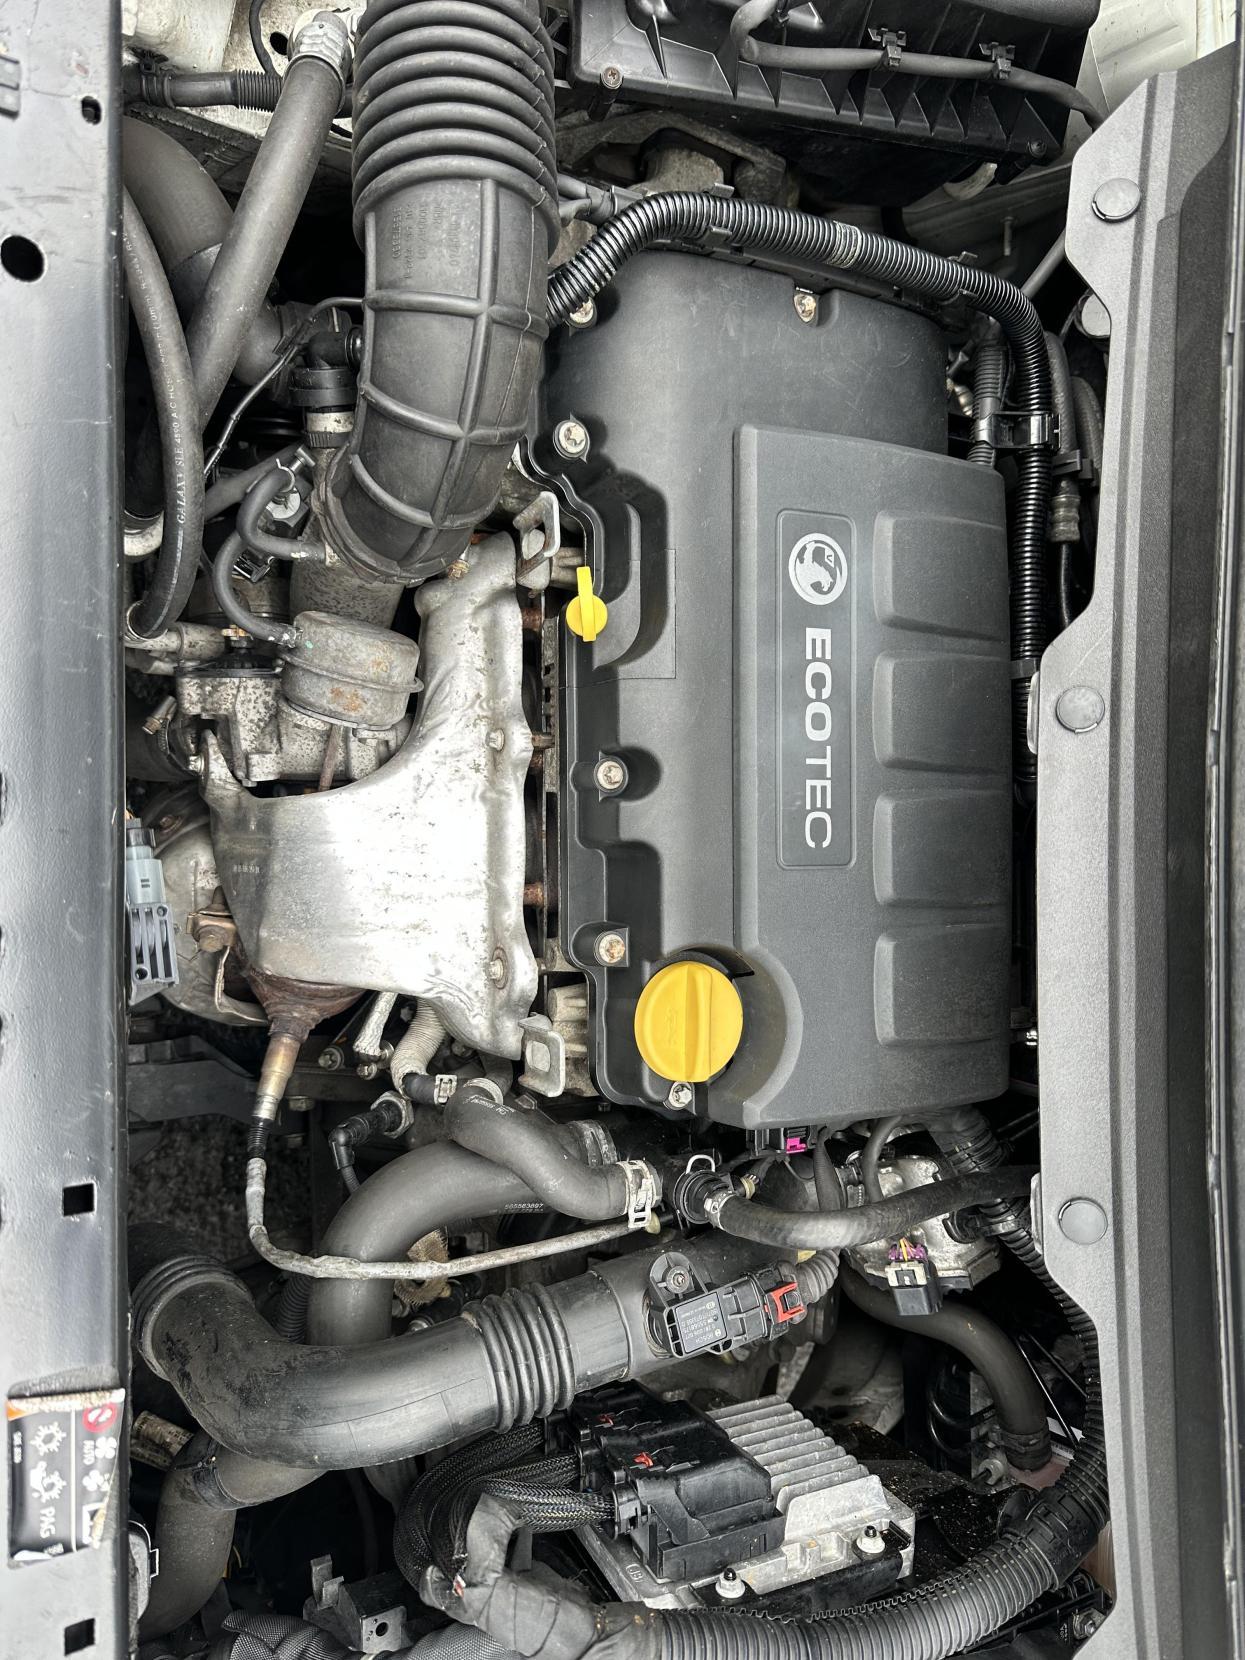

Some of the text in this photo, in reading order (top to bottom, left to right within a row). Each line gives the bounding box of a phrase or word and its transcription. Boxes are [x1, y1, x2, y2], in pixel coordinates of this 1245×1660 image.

[174, 447, 185, 467] SLE
[805, 627, 832, 849] ECOTEC
[40, 1506, 56, 1538] PAG
